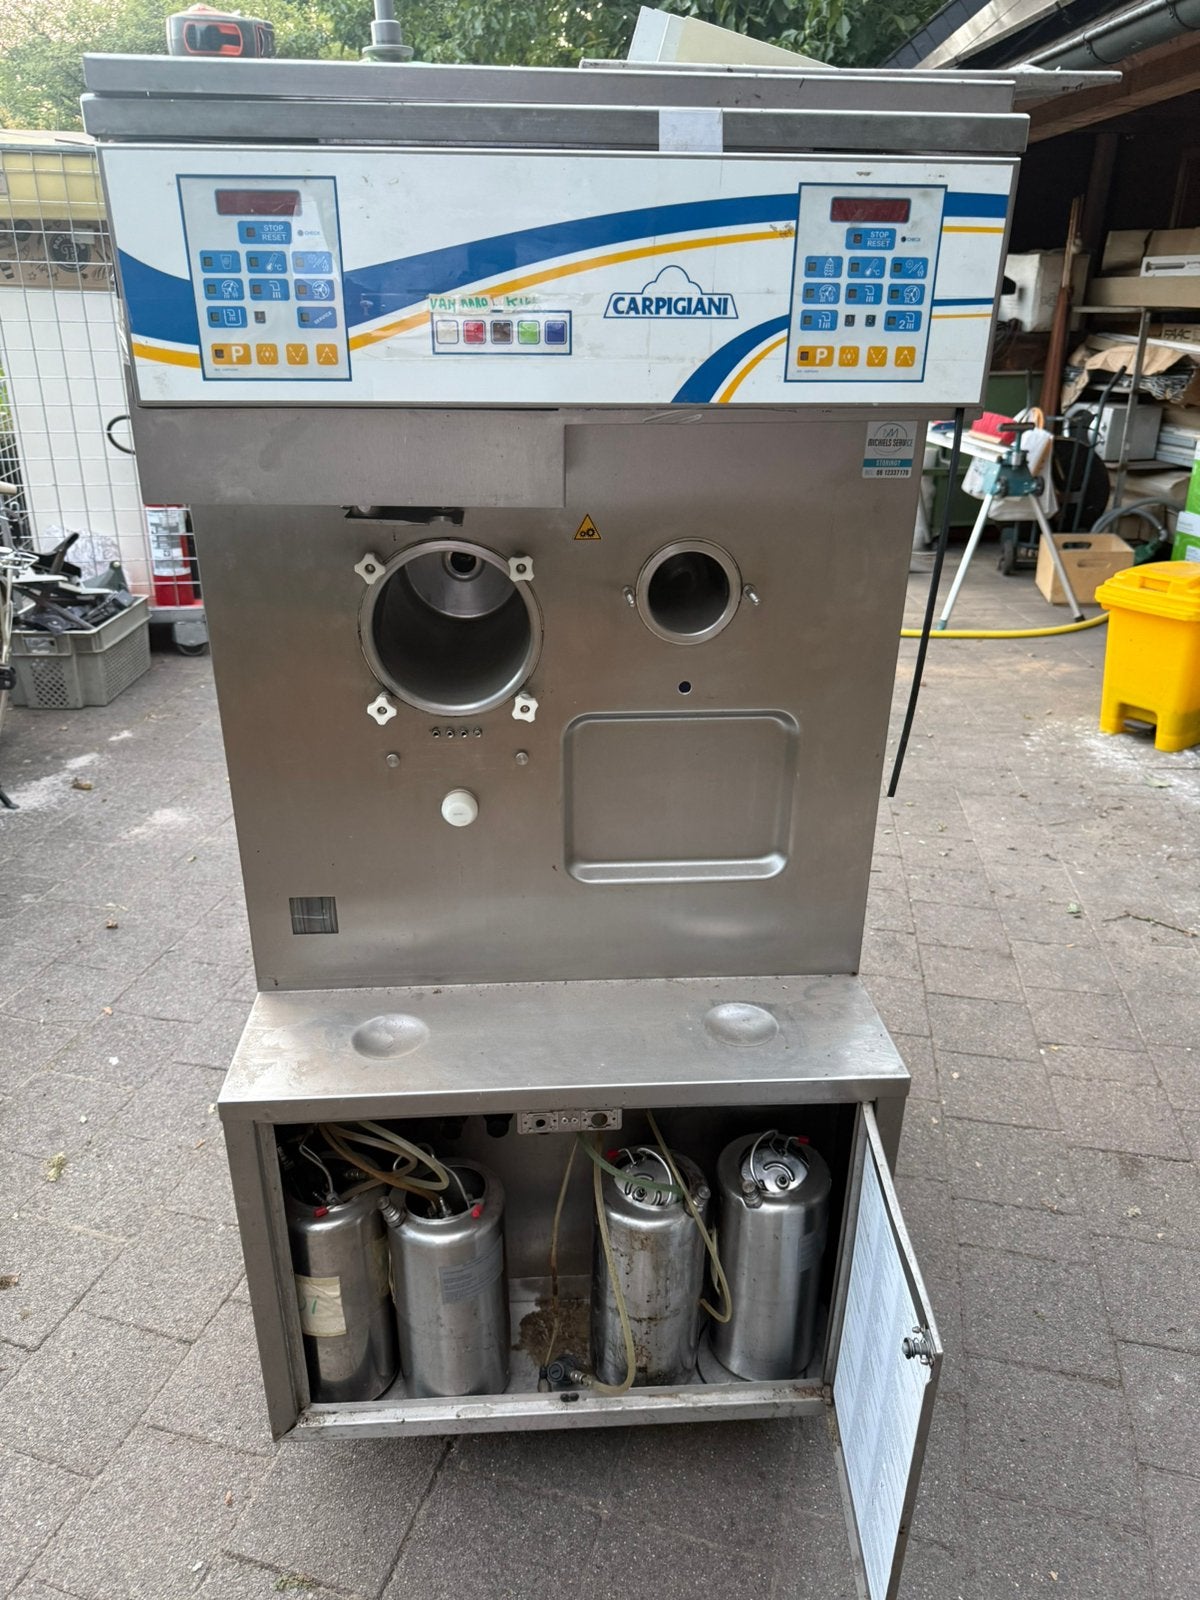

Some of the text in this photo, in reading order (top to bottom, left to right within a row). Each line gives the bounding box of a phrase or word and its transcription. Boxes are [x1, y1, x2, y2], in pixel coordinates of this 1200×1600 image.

[263, 224, 284, 232] STOP
[612, 296, 729, 316] CARPIGIANI
[231, 346, 245, 362] P
[815, 348, 829, 365] P
